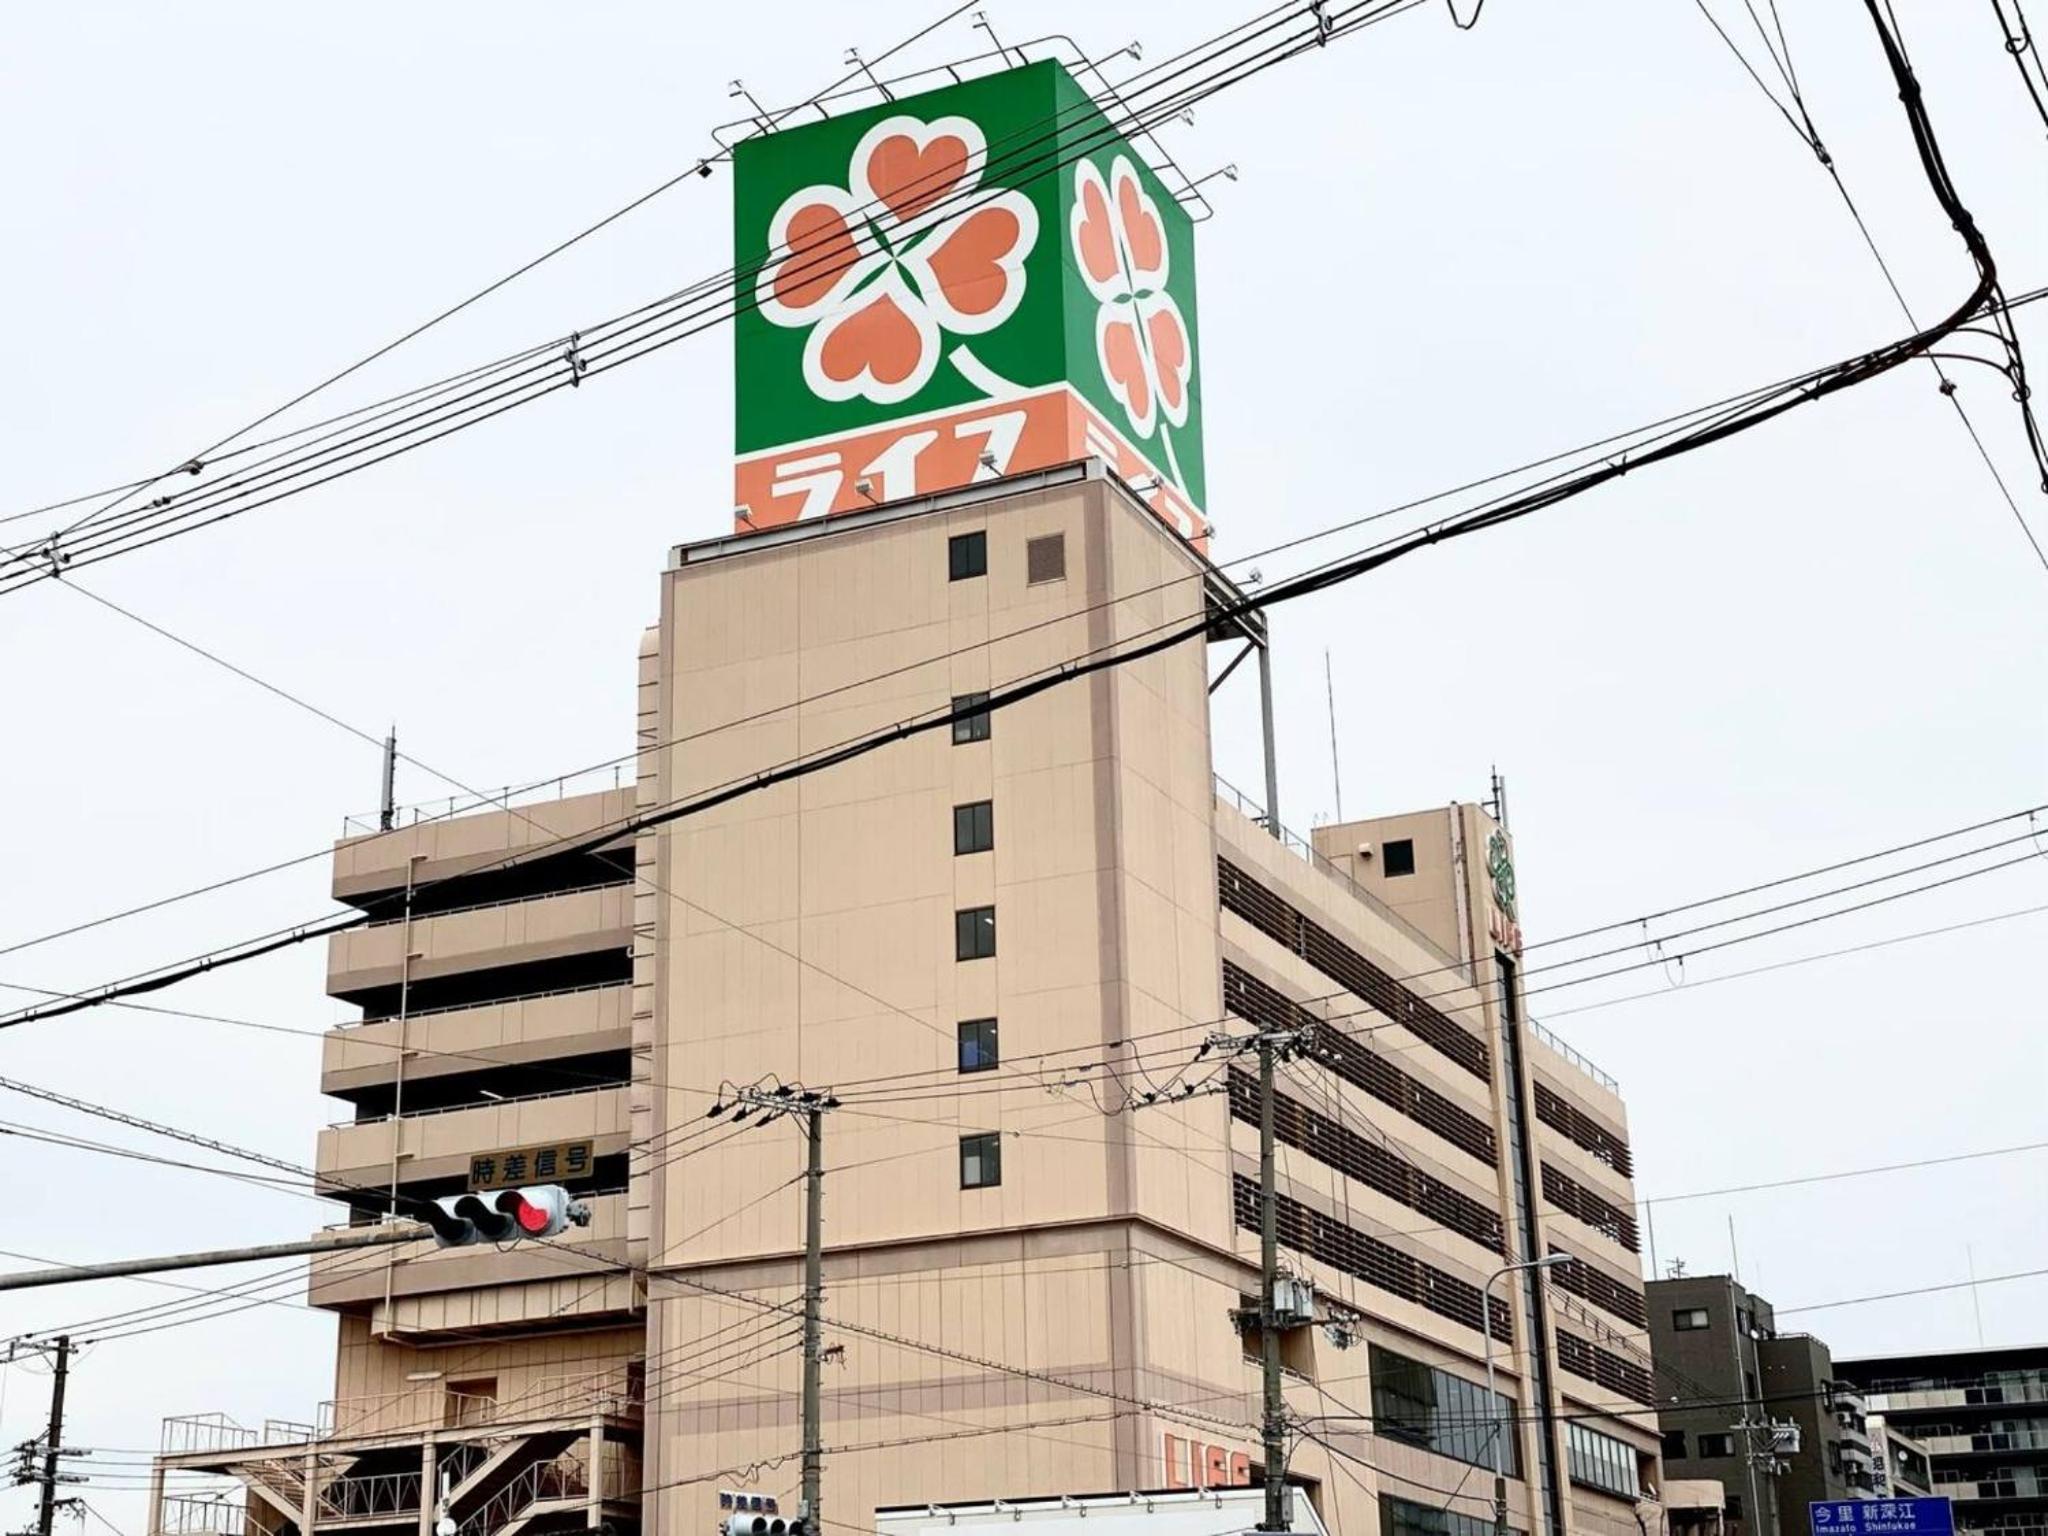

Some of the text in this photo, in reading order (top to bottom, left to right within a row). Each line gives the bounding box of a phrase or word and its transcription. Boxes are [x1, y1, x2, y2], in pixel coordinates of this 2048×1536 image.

[771, 410, 1026, 521] ライフ
[472, 1146, 588, 1184] 時差信号
[1862, 1503, 1916, 1521] 新深江
